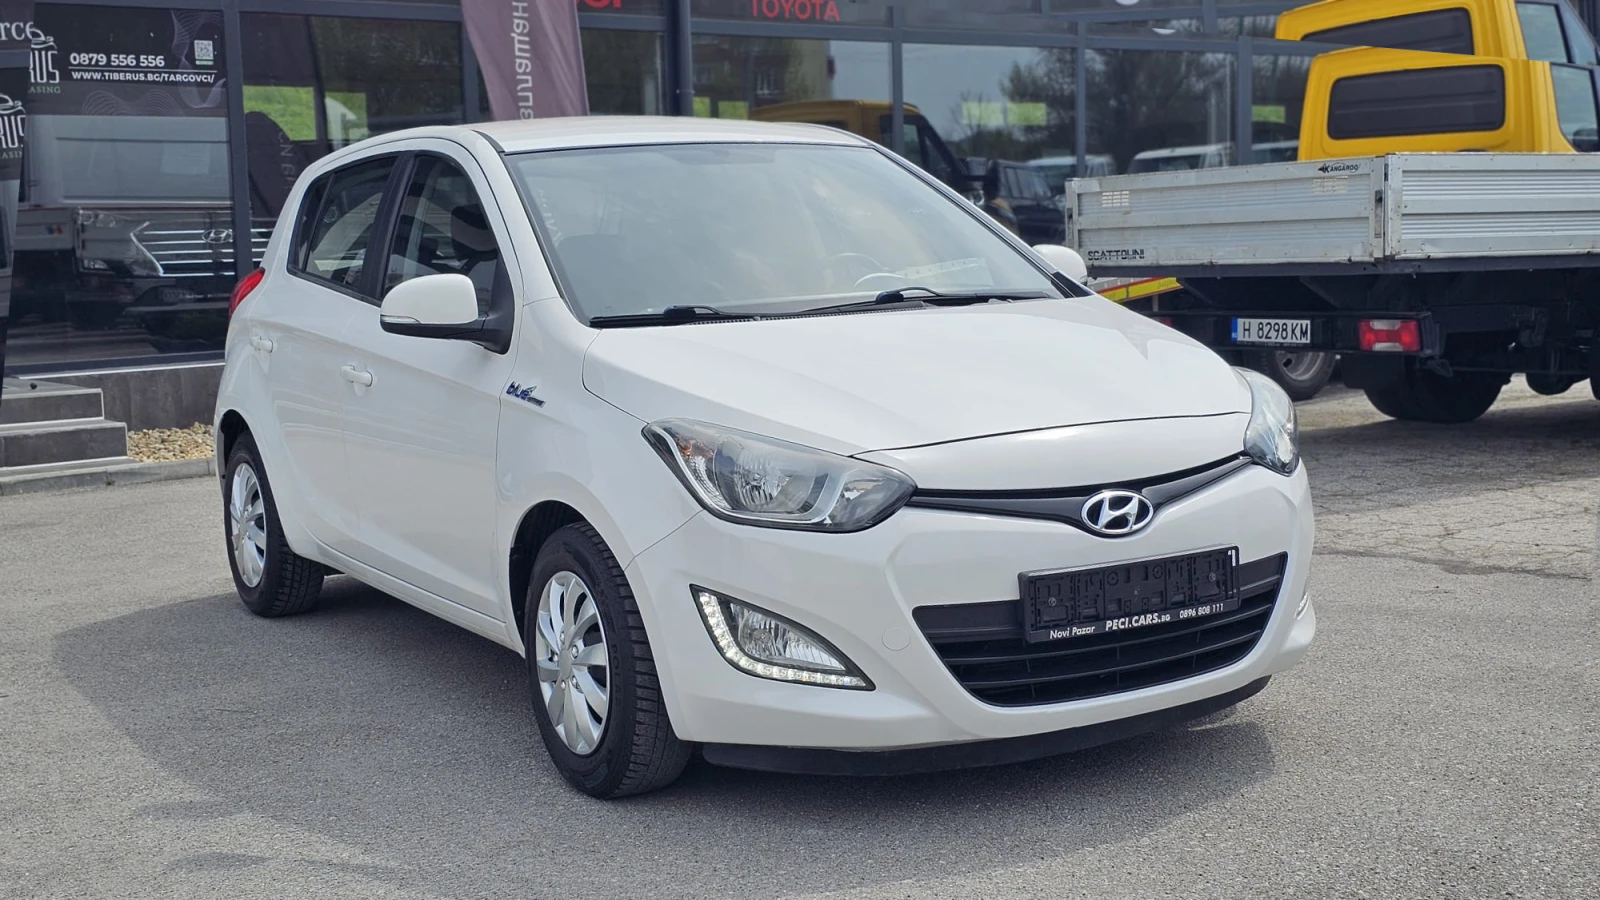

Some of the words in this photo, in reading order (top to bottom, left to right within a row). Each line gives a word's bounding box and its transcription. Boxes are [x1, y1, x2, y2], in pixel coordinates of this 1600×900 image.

[750, 0, 840, 22] TOYOTA
[69, 52, 107, 66] 0879
[110, 53, 137, 67] 556
[139, 54, 165, 67] 556
[71, 71, 215, 84] WWW.TIBERUS.BG/TARGOVCI/
[1323, 163, 1359, 174] KANGAROO
[1242, 321, 1251, 339] H
[1049, 627, 1070, 640] Novi
[1072, 626, 1096, 636] Pazar
[1179, 609, 1197, 619] 0896
[1198, 605, 1211, 616] 808
[1212, 602, 1224, 613] 111
